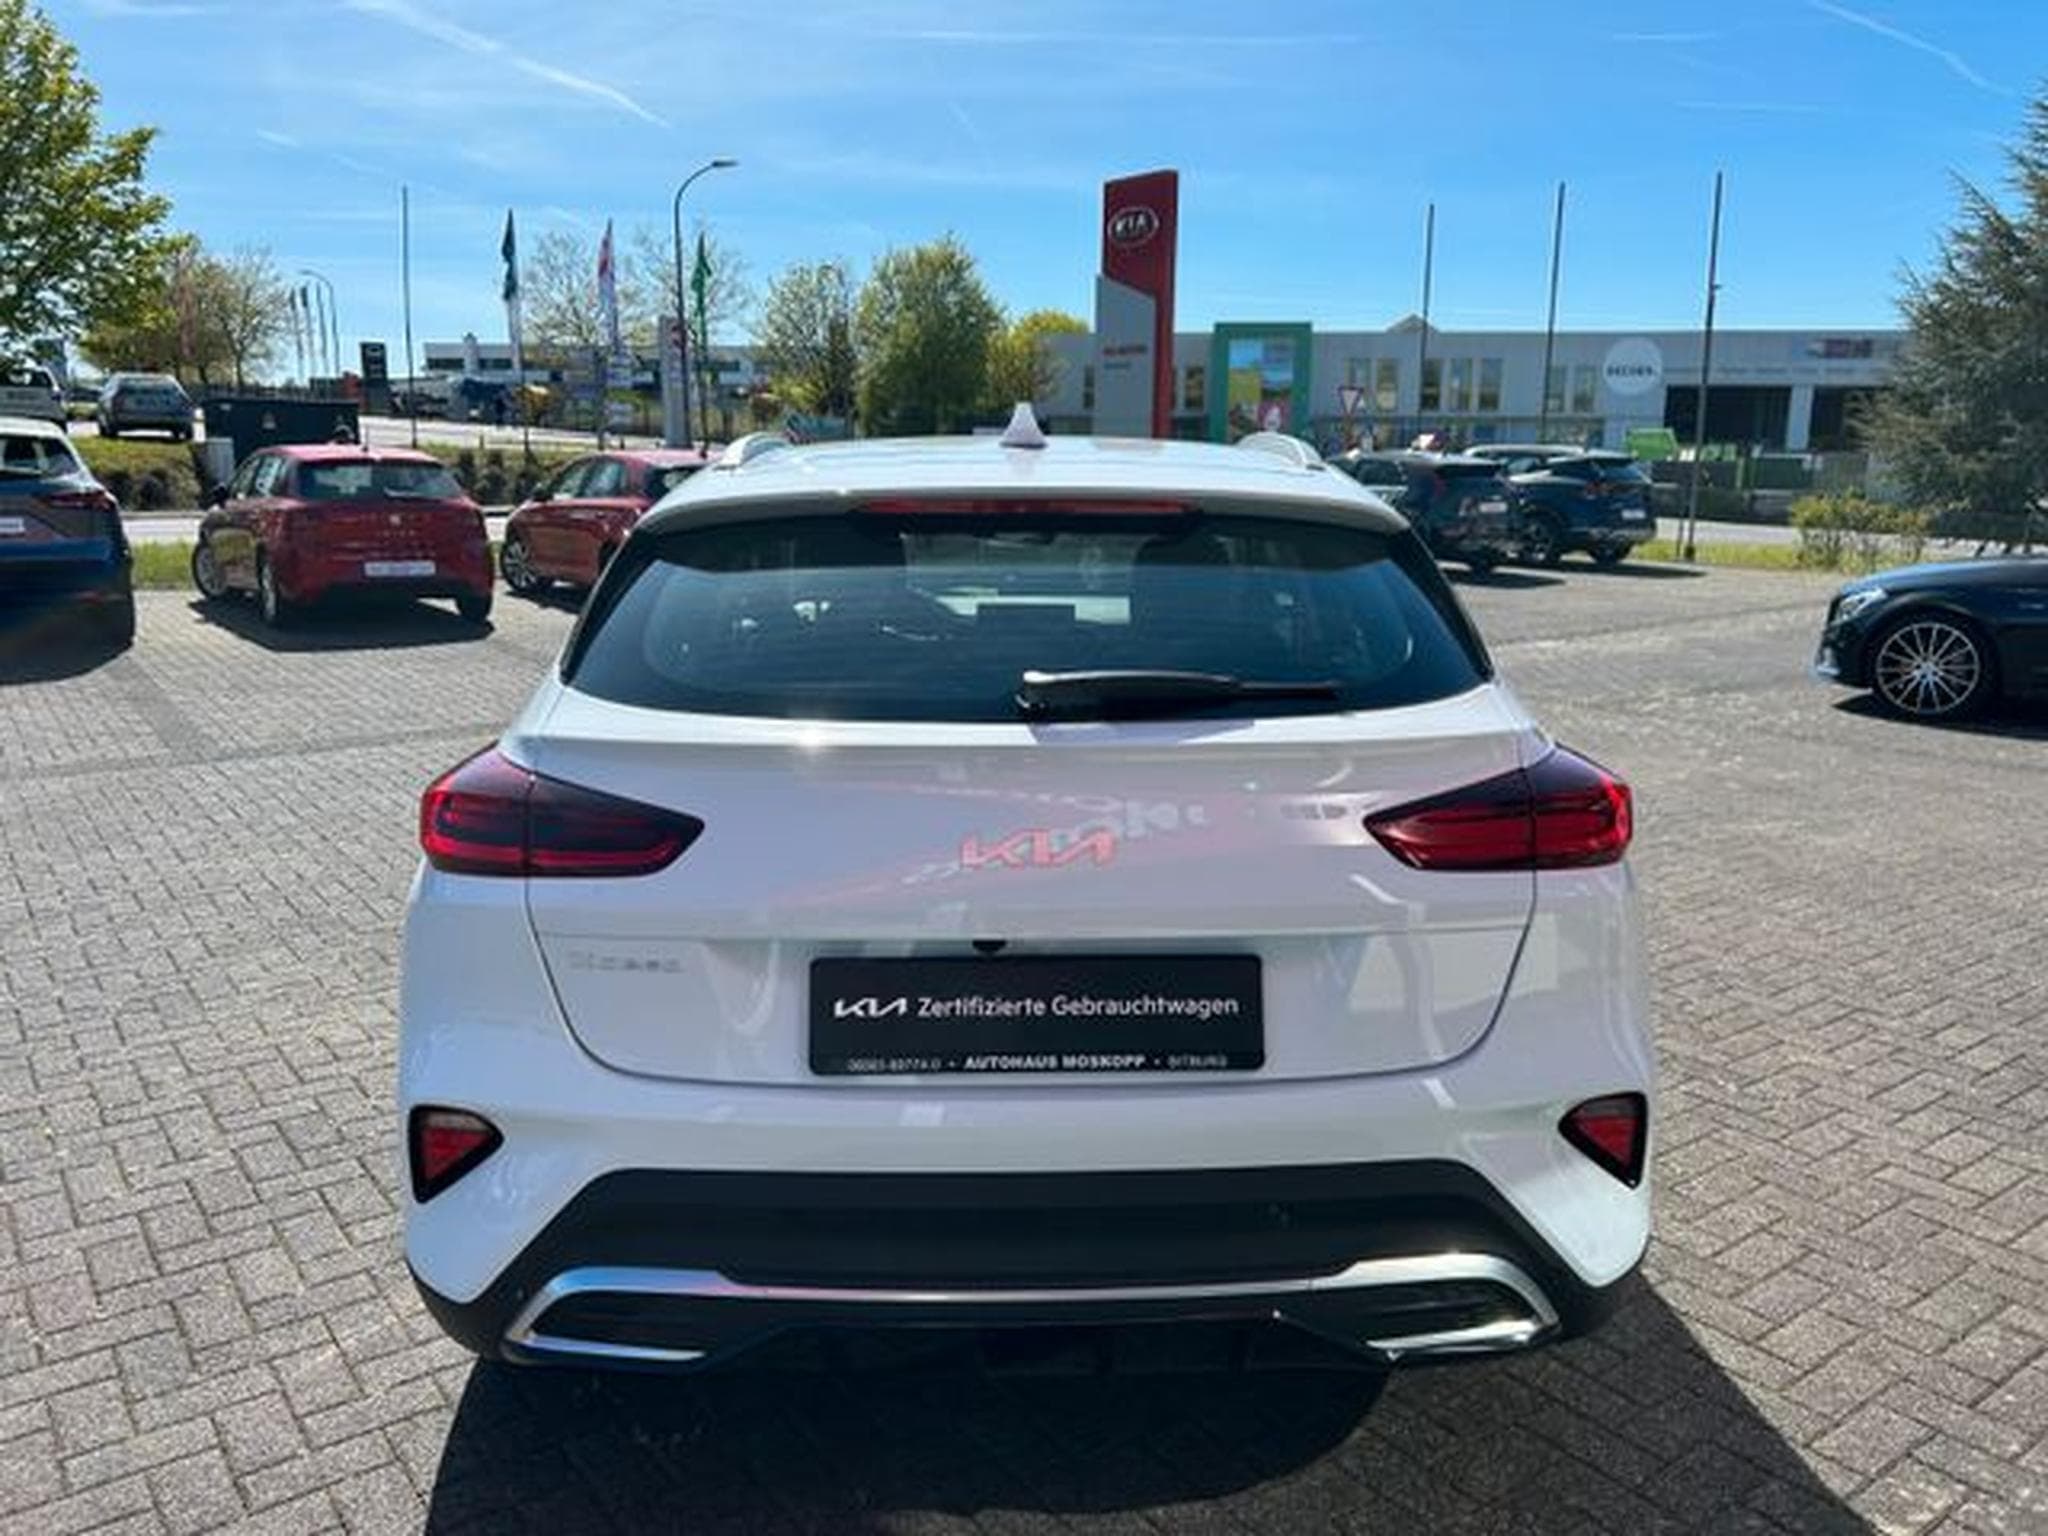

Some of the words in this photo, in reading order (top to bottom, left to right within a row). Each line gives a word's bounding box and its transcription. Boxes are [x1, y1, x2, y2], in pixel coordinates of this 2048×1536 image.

[960, 828, 1120, 871] KIA
[834, 997, 907, 1018] KIA
[917, 996, 1047, 1018] Zertifizierte
[1051, 995, 1240, 1021] Gebrauchtwagen
[964, 1054, 1058, 1070] AUTOHAUS
[1061, 1054, 1147, 1069] MOSKOPP
